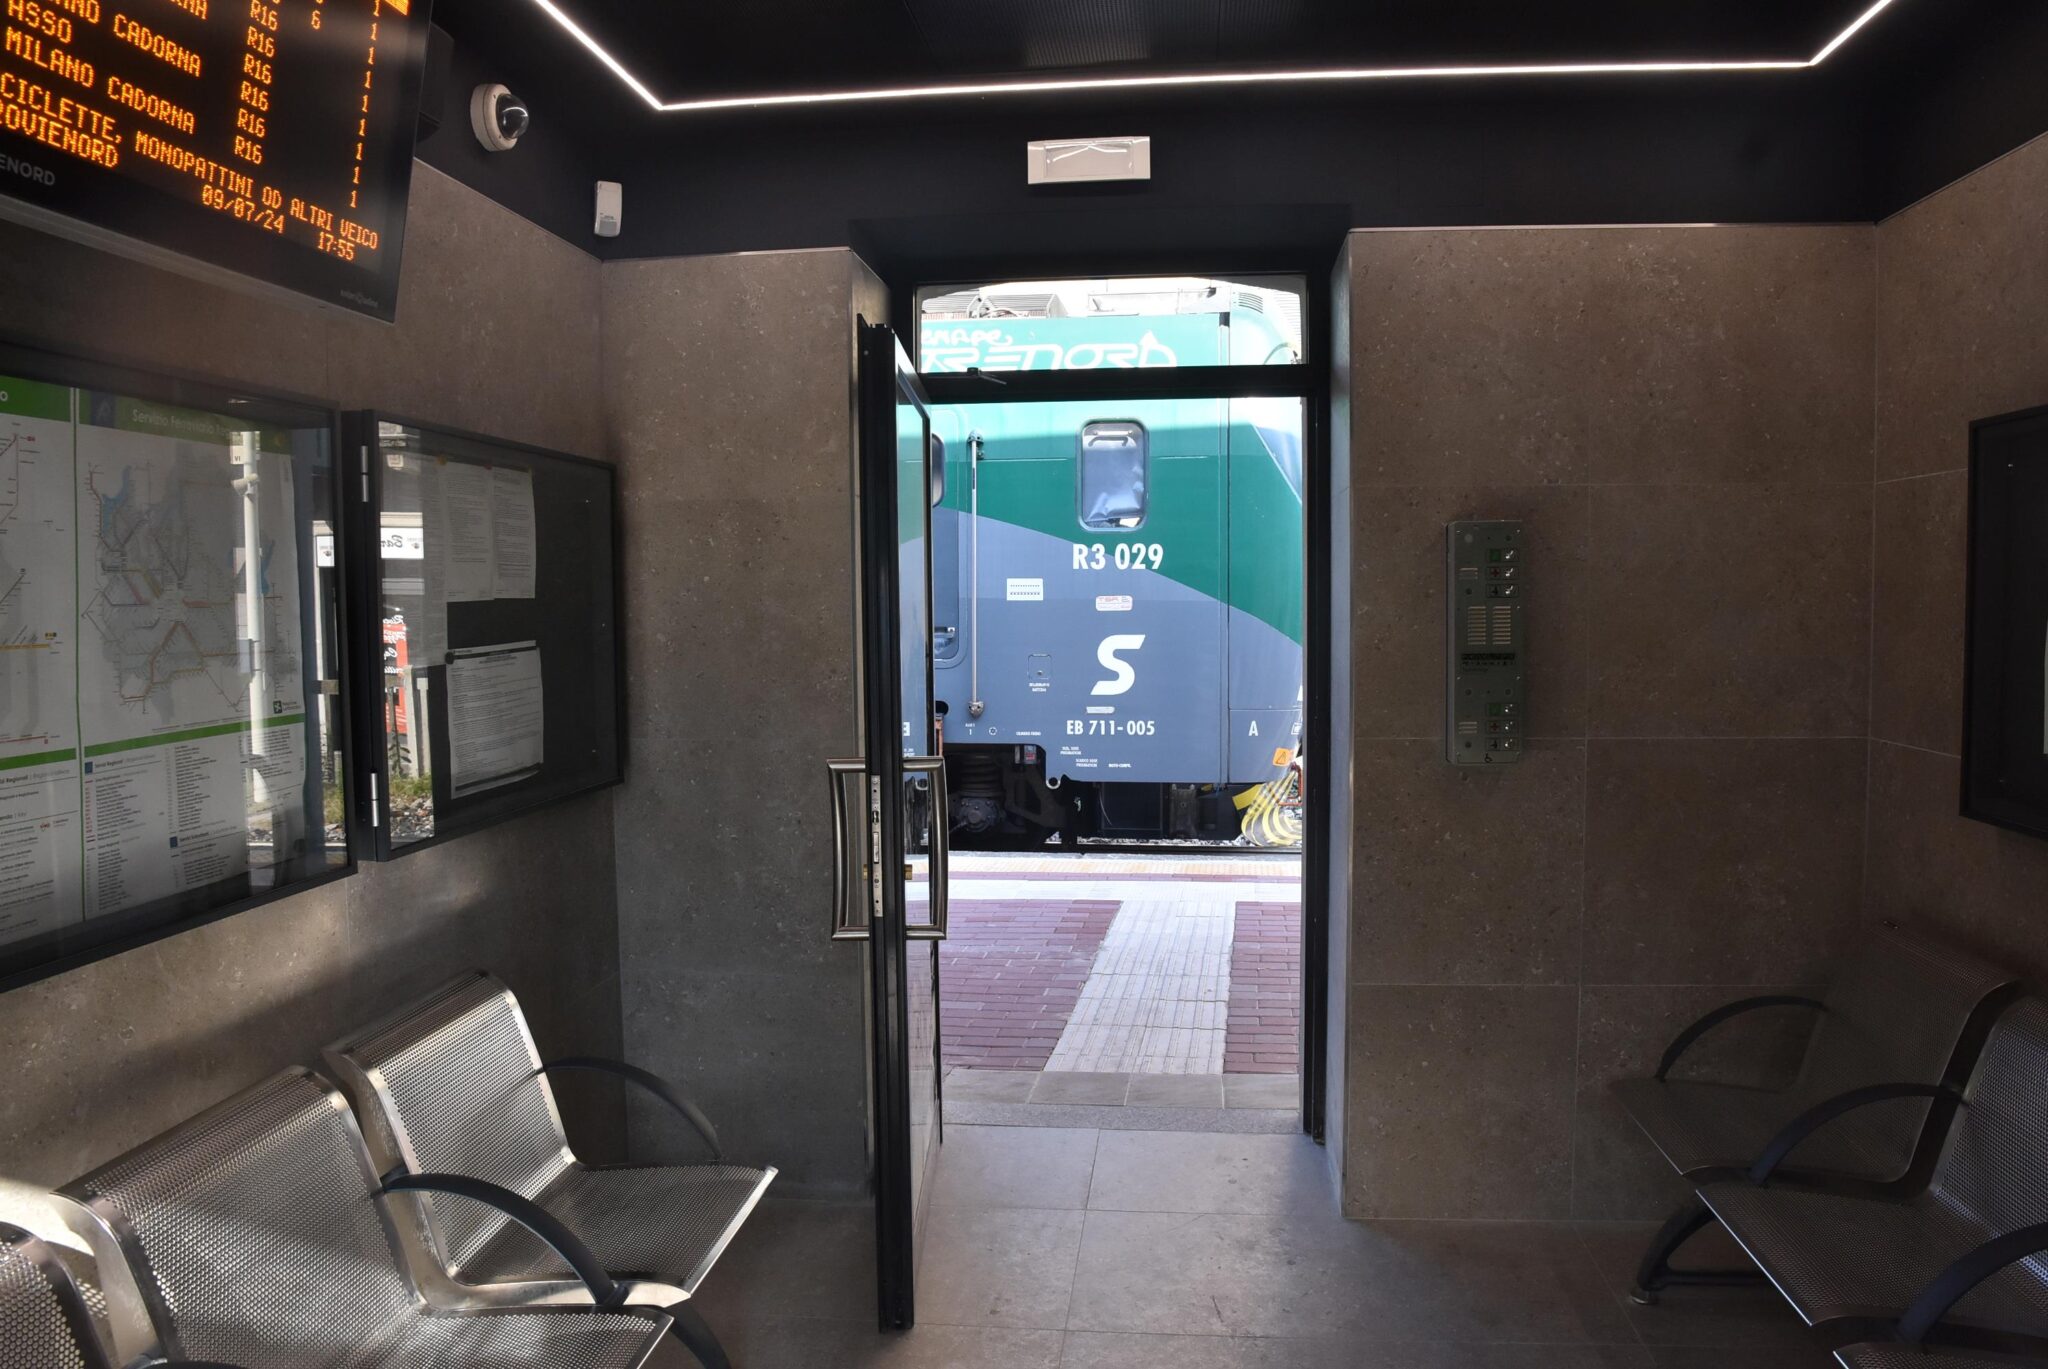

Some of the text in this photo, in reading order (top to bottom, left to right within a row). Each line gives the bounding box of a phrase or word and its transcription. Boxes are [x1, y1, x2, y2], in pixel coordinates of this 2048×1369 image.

[247, 26, 275, 58] R16
[361, 95, 369, 112] 1
[249, 0, 372, 89] R16 1
[310, 10, 375, 65] 6 1
[369, 22, 378, 41] 1
[6, 26, 358, 208] MILANO CADORNA R16 1
[113, 14, 201, 77] CADORNA
[240, 81, 268, 111] R16
[355, 142, 363, 160] 1
[244, 53, 366, 136] R16 1
[237, 108, 265, 138] R16
[352, 166, 360, 184] 1
[135, 131, 253, 198] MONOPATTINI
[262, 185, 283, 210] OD
[290, 198, 332, 232] ALTRI
[340, 217, 380, 250] VEICO
[201, 184, 286, 234] 09/07/24
[317, 231, 355, 261] 17:55
[1073, 543, 1164, 570] R3 029
[1089, 634, 1146, 695] S
[1066, 720, 1084, 736] EB
[1248, 721, 1260, 738] A
